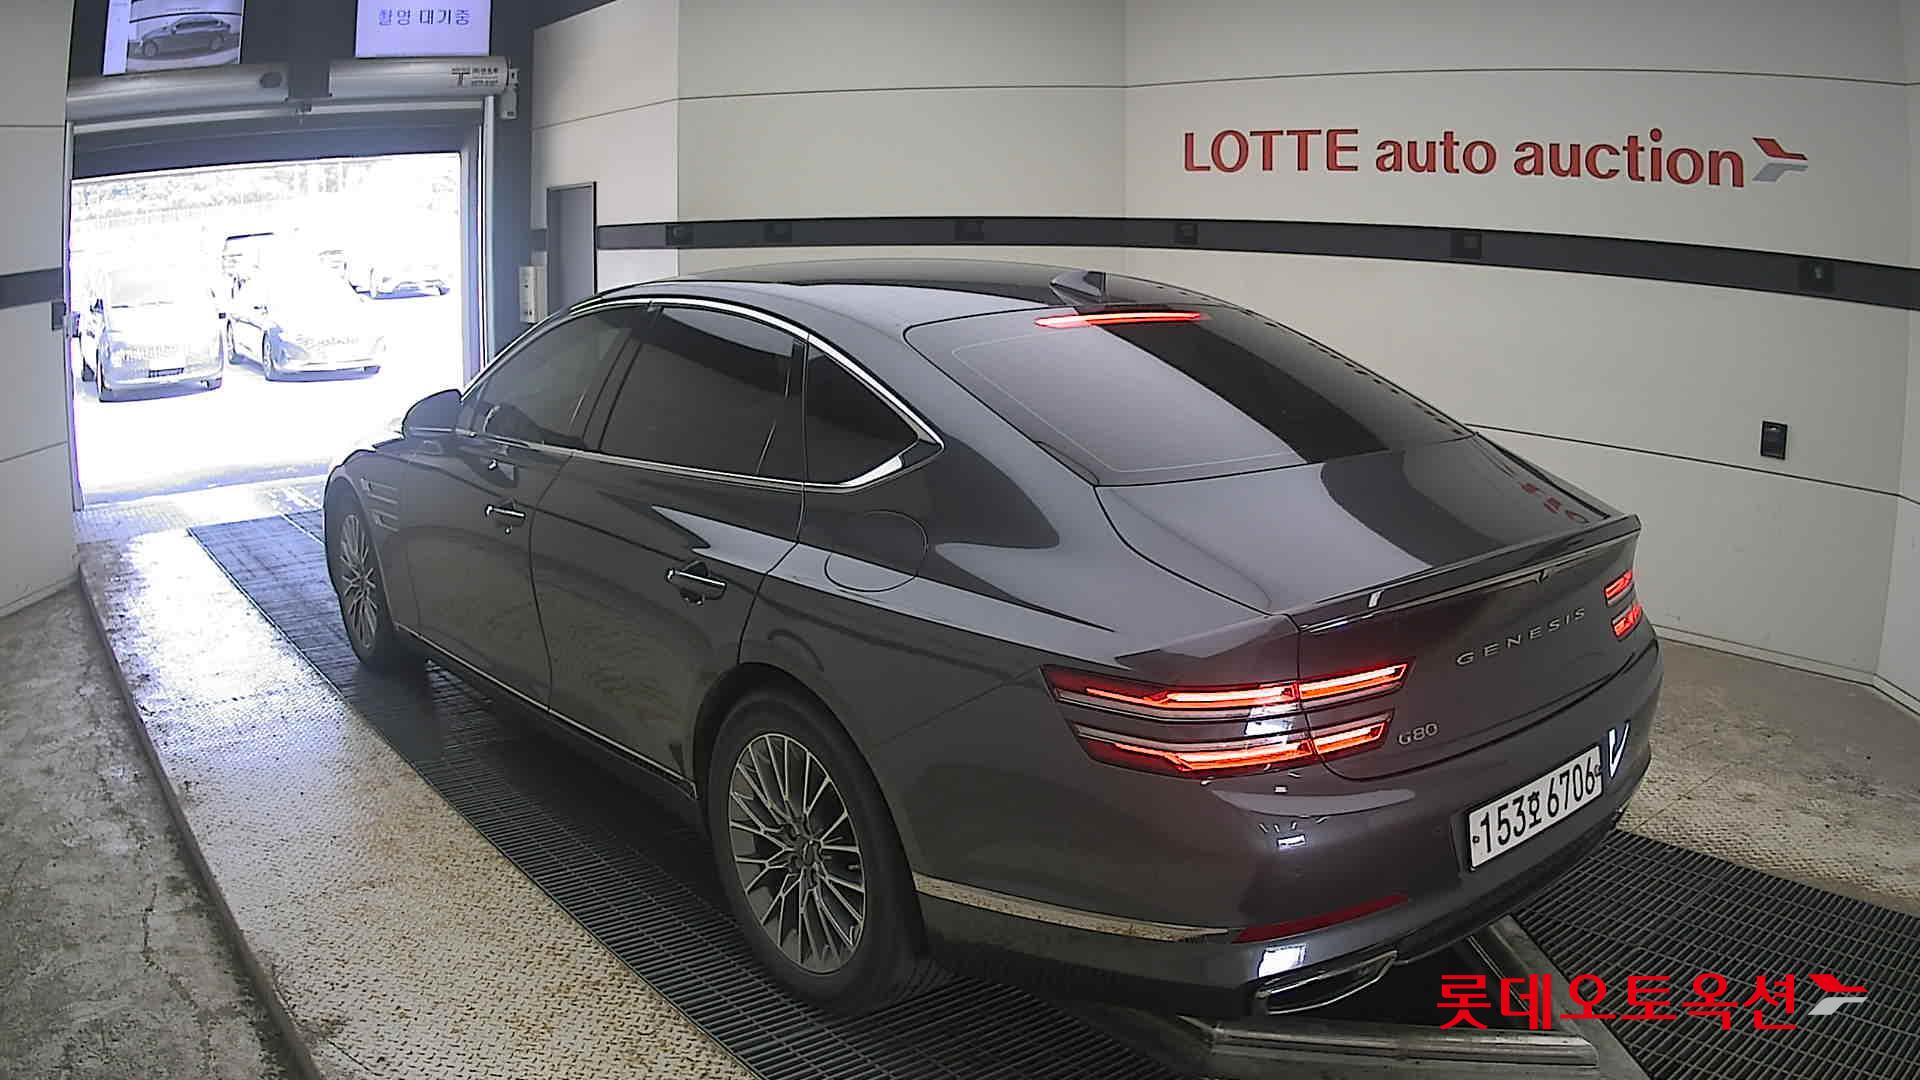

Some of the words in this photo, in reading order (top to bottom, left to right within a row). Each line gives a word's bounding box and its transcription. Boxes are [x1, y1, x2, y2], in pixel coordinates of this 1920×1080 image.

[419, 8, 470, 26] 대기중
[1184, 129, 1359, 171] LOTTE
[1376, 131, 1497, 174] auto
[1514, 128, 1744, 188] auction
[1456, 608, 1585, 665] GENESIS
[1398, 723, 1439, 745] G80
[1479, 791, 1542, 853] 153호
[1547, 757, 1596, 818] 6706
